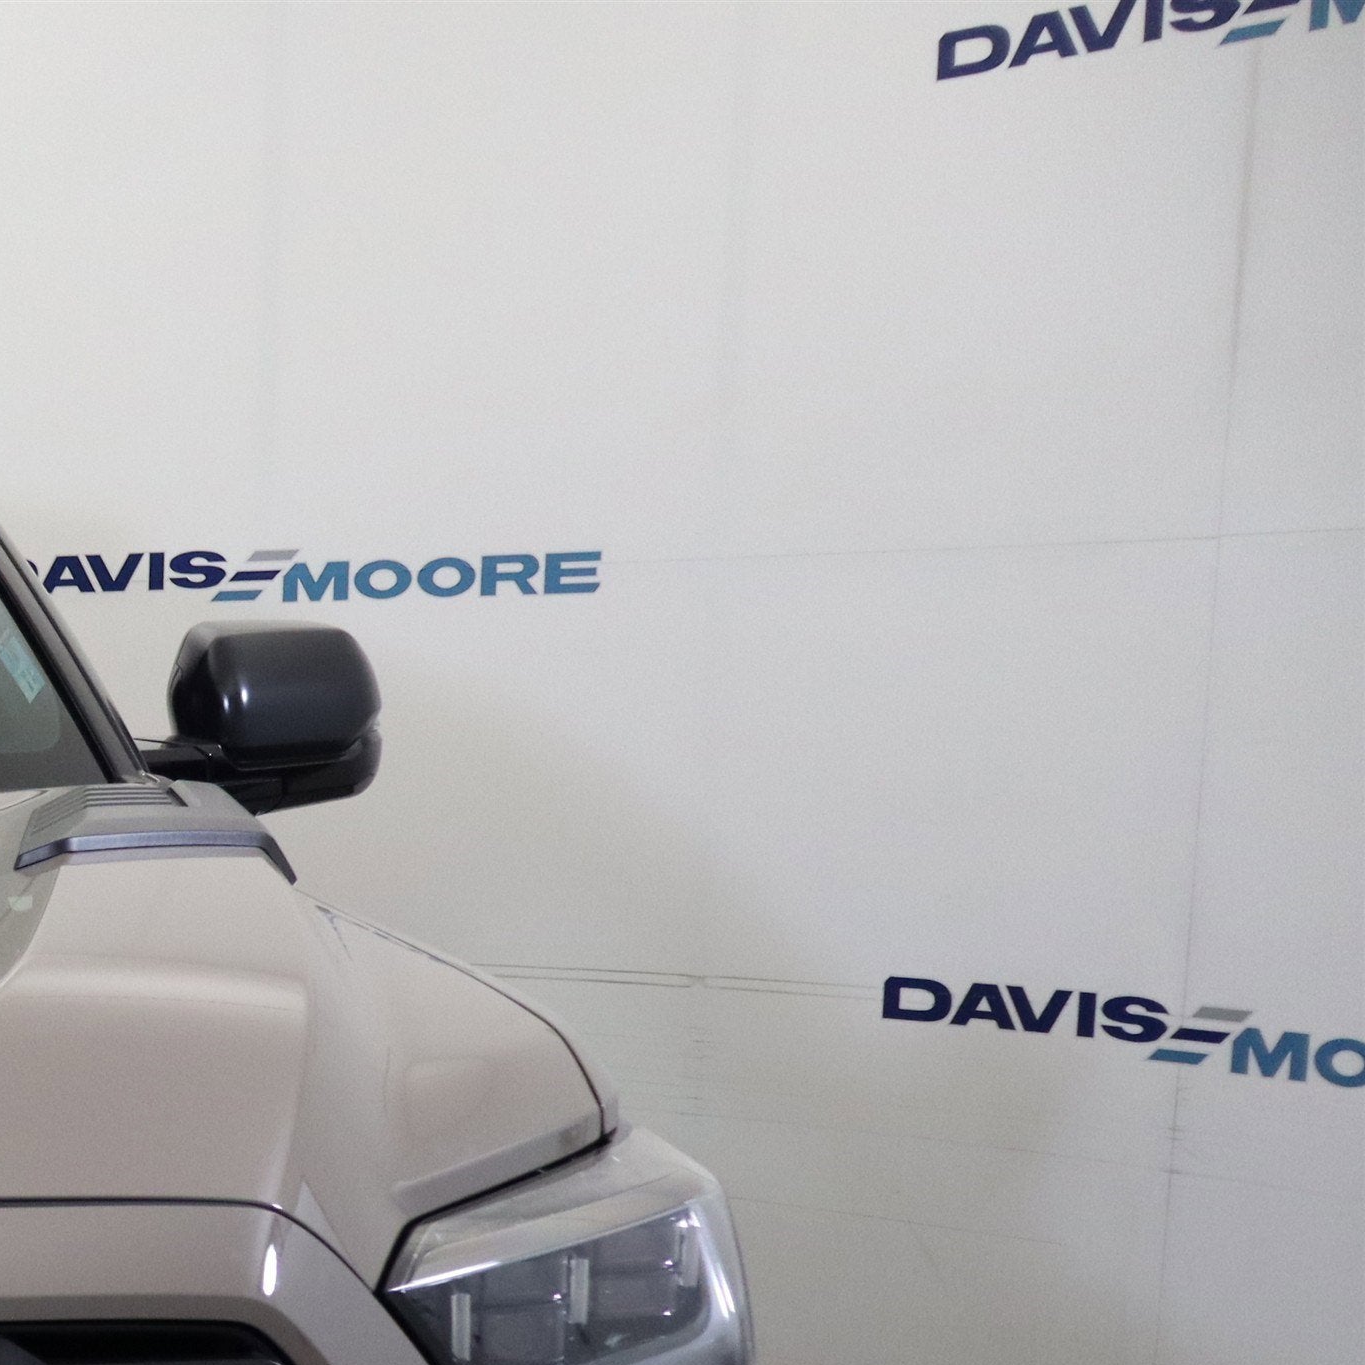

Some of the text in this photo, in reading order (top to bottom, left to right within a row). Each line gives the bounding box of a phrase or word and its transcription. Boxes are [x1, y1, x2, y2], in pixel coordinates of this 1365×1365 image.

[936, 0, 1240, 81] DAVIS
[24, 550, 603, 603] AVIS MOORE
[882, 975, 1365, 1088] DAVIS MO
